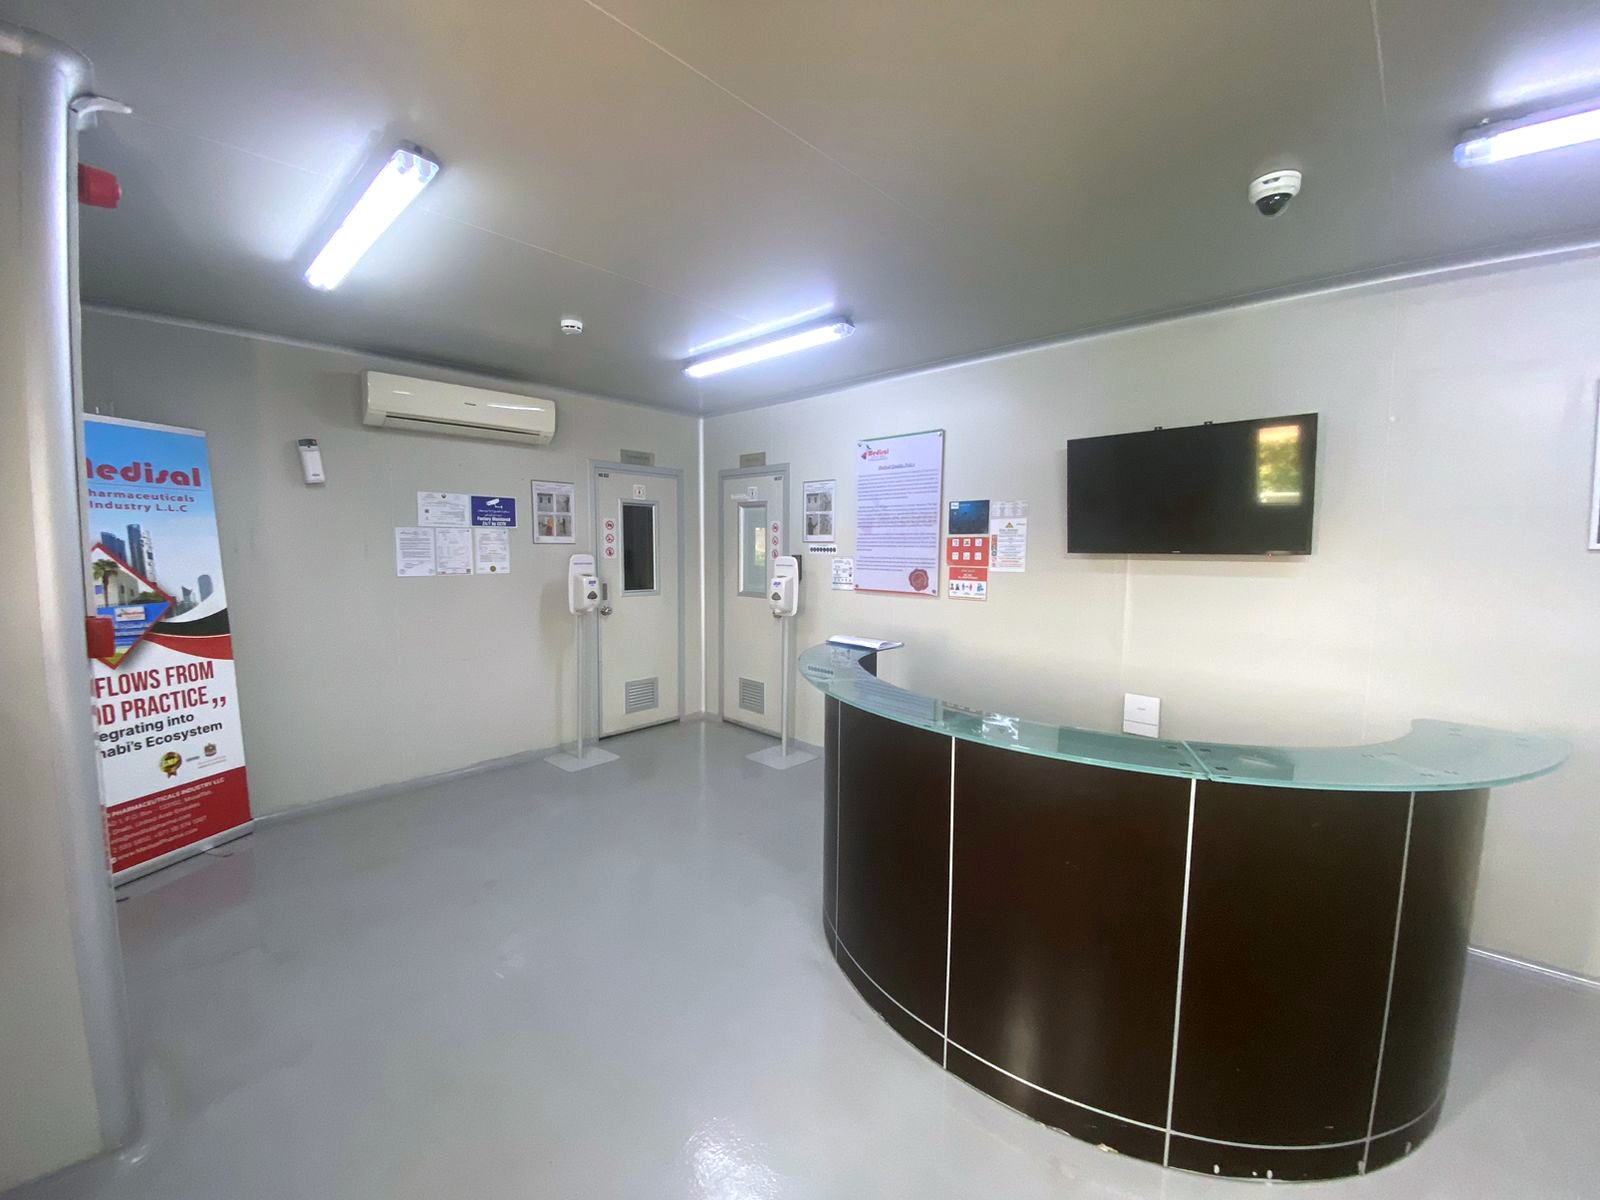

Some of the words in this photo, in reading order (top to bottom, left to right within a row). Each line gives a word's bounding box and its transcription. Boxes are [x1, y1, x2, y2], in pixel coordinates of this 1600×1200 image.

[89, 500, 152, 513] Industry
[95, 668, 161, 698] FLOWS
[165, 661, 214, 686] FROM
[168, 713, 194, 727] into
[146, 722, 223, 748] Ecosystem
